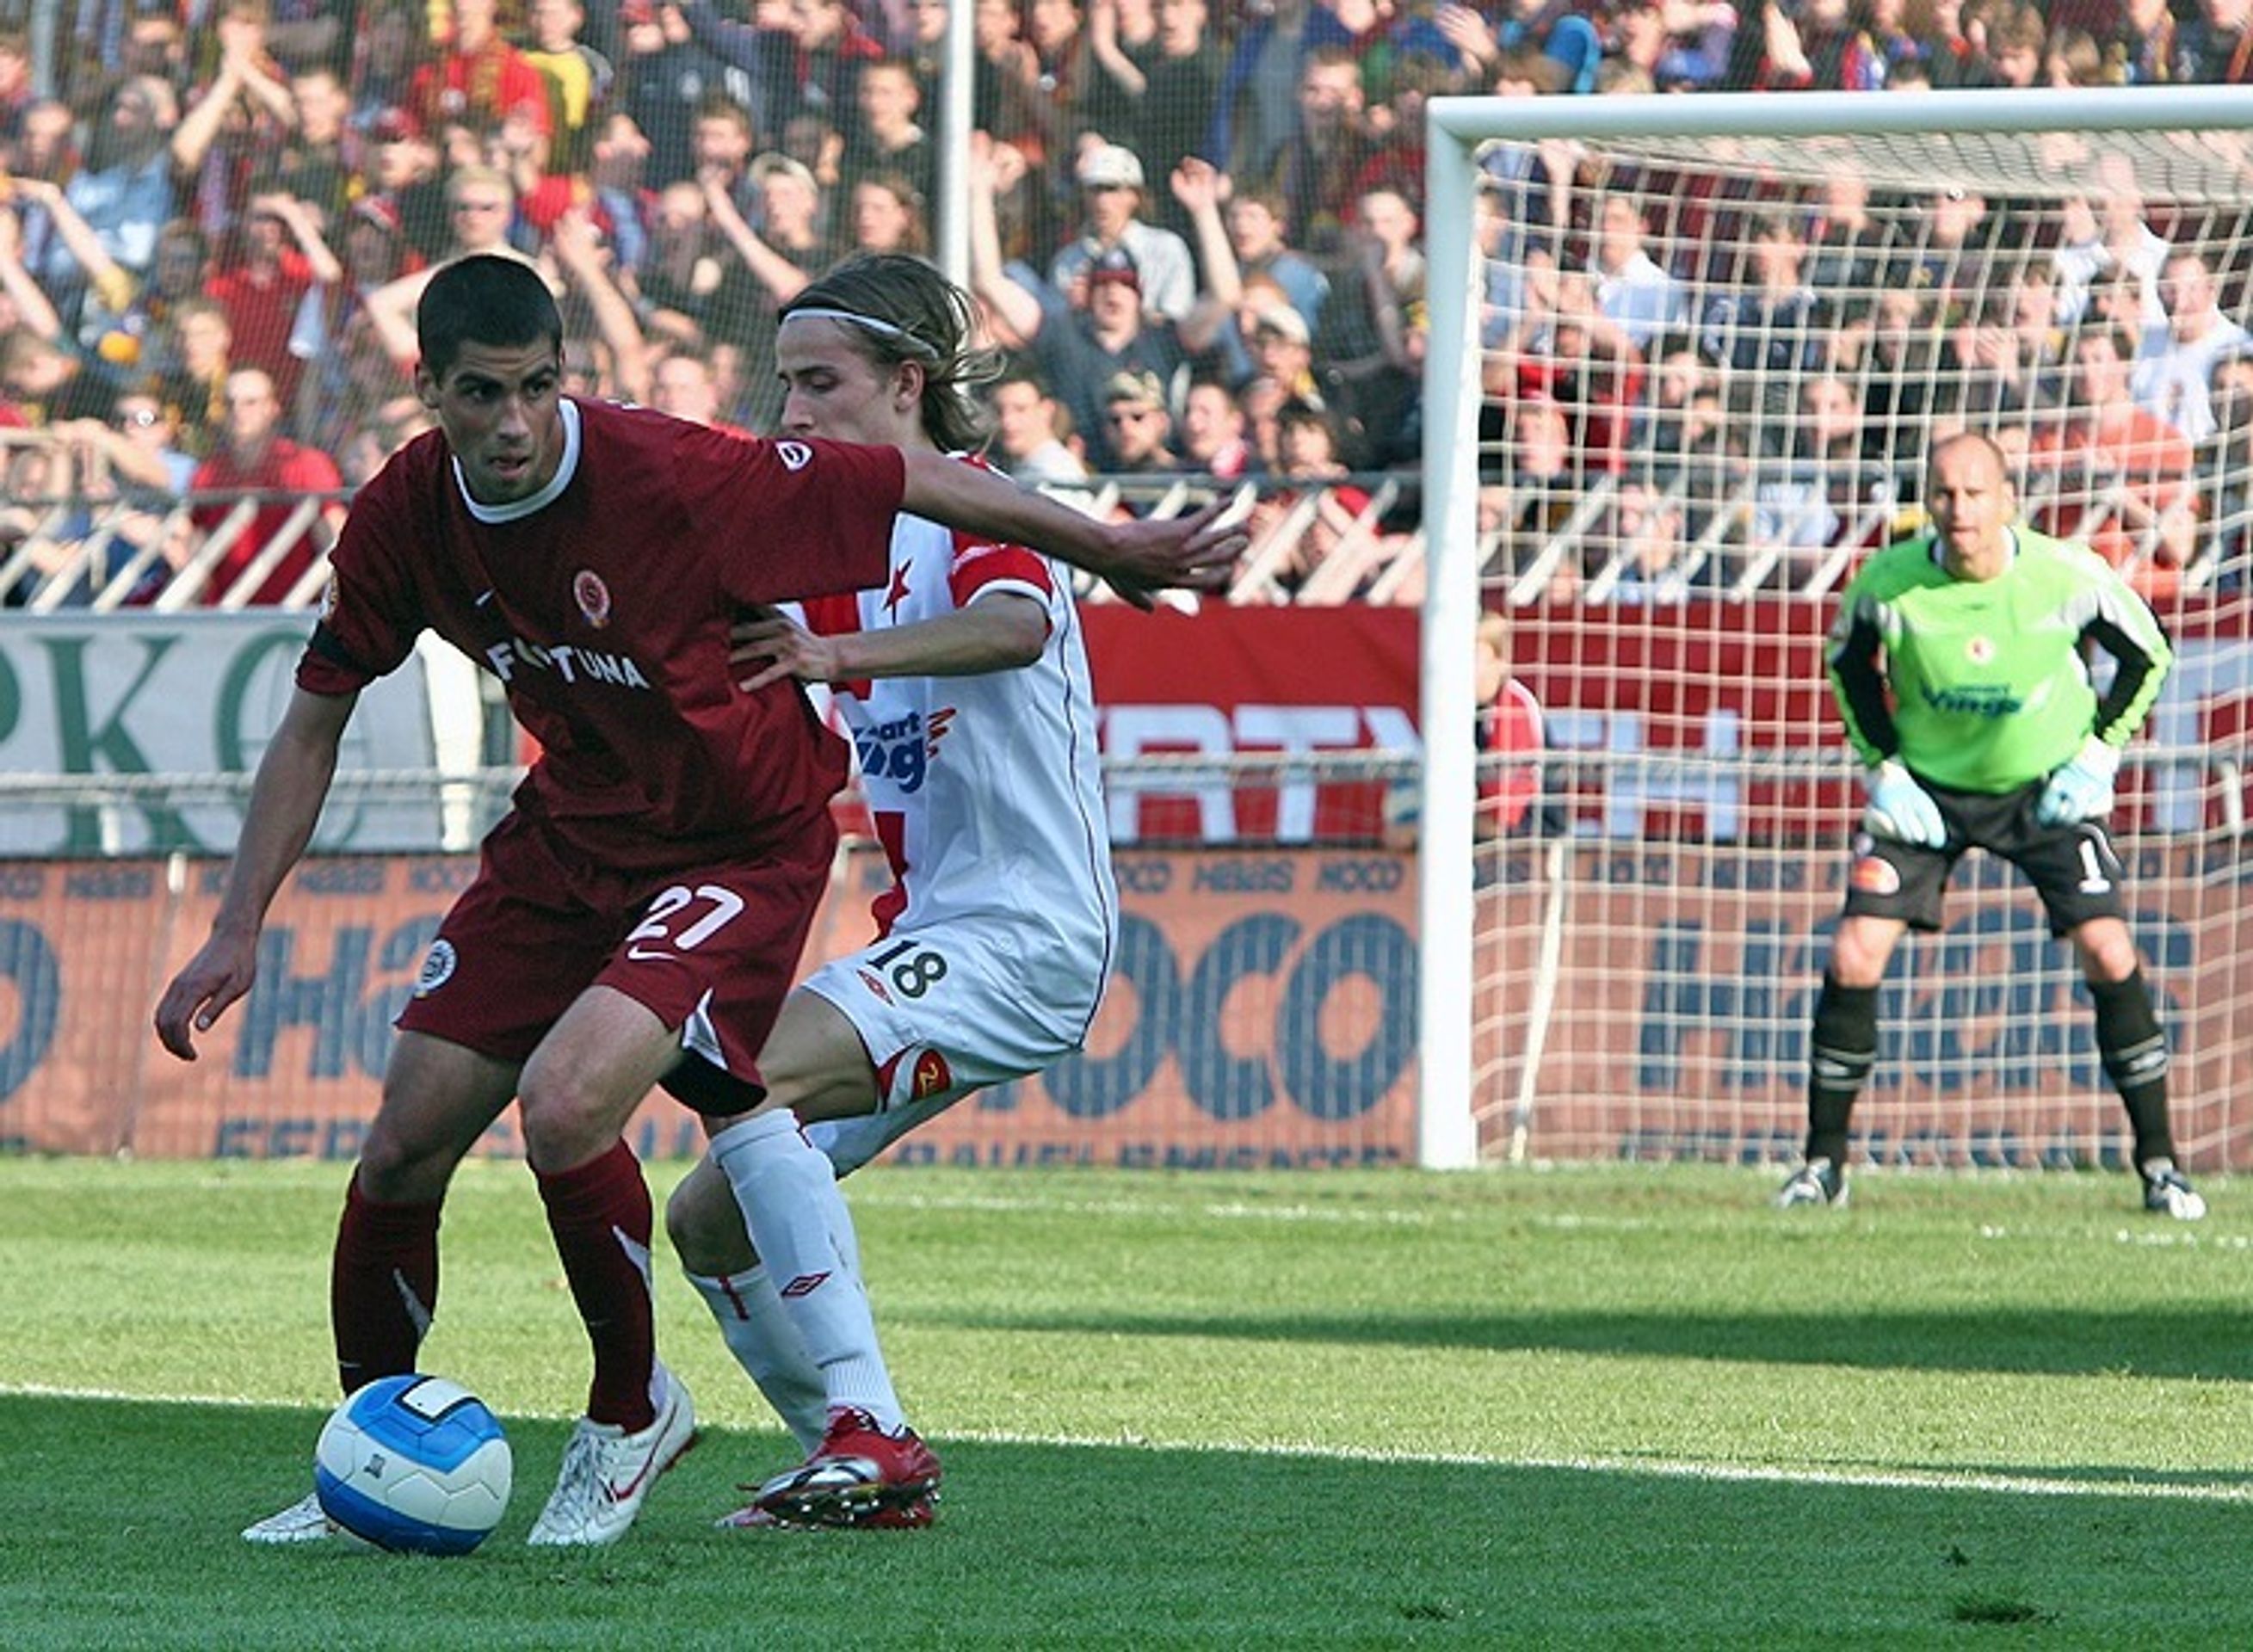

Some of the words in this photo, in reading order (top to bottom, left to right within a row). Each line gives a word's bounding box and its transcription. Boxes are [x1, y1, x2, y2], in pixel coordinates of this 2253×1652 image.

[2078, 838, 2111, 893] 1
[626, 885, 744, 950] 27
[866, 940, 947, 998] 18
